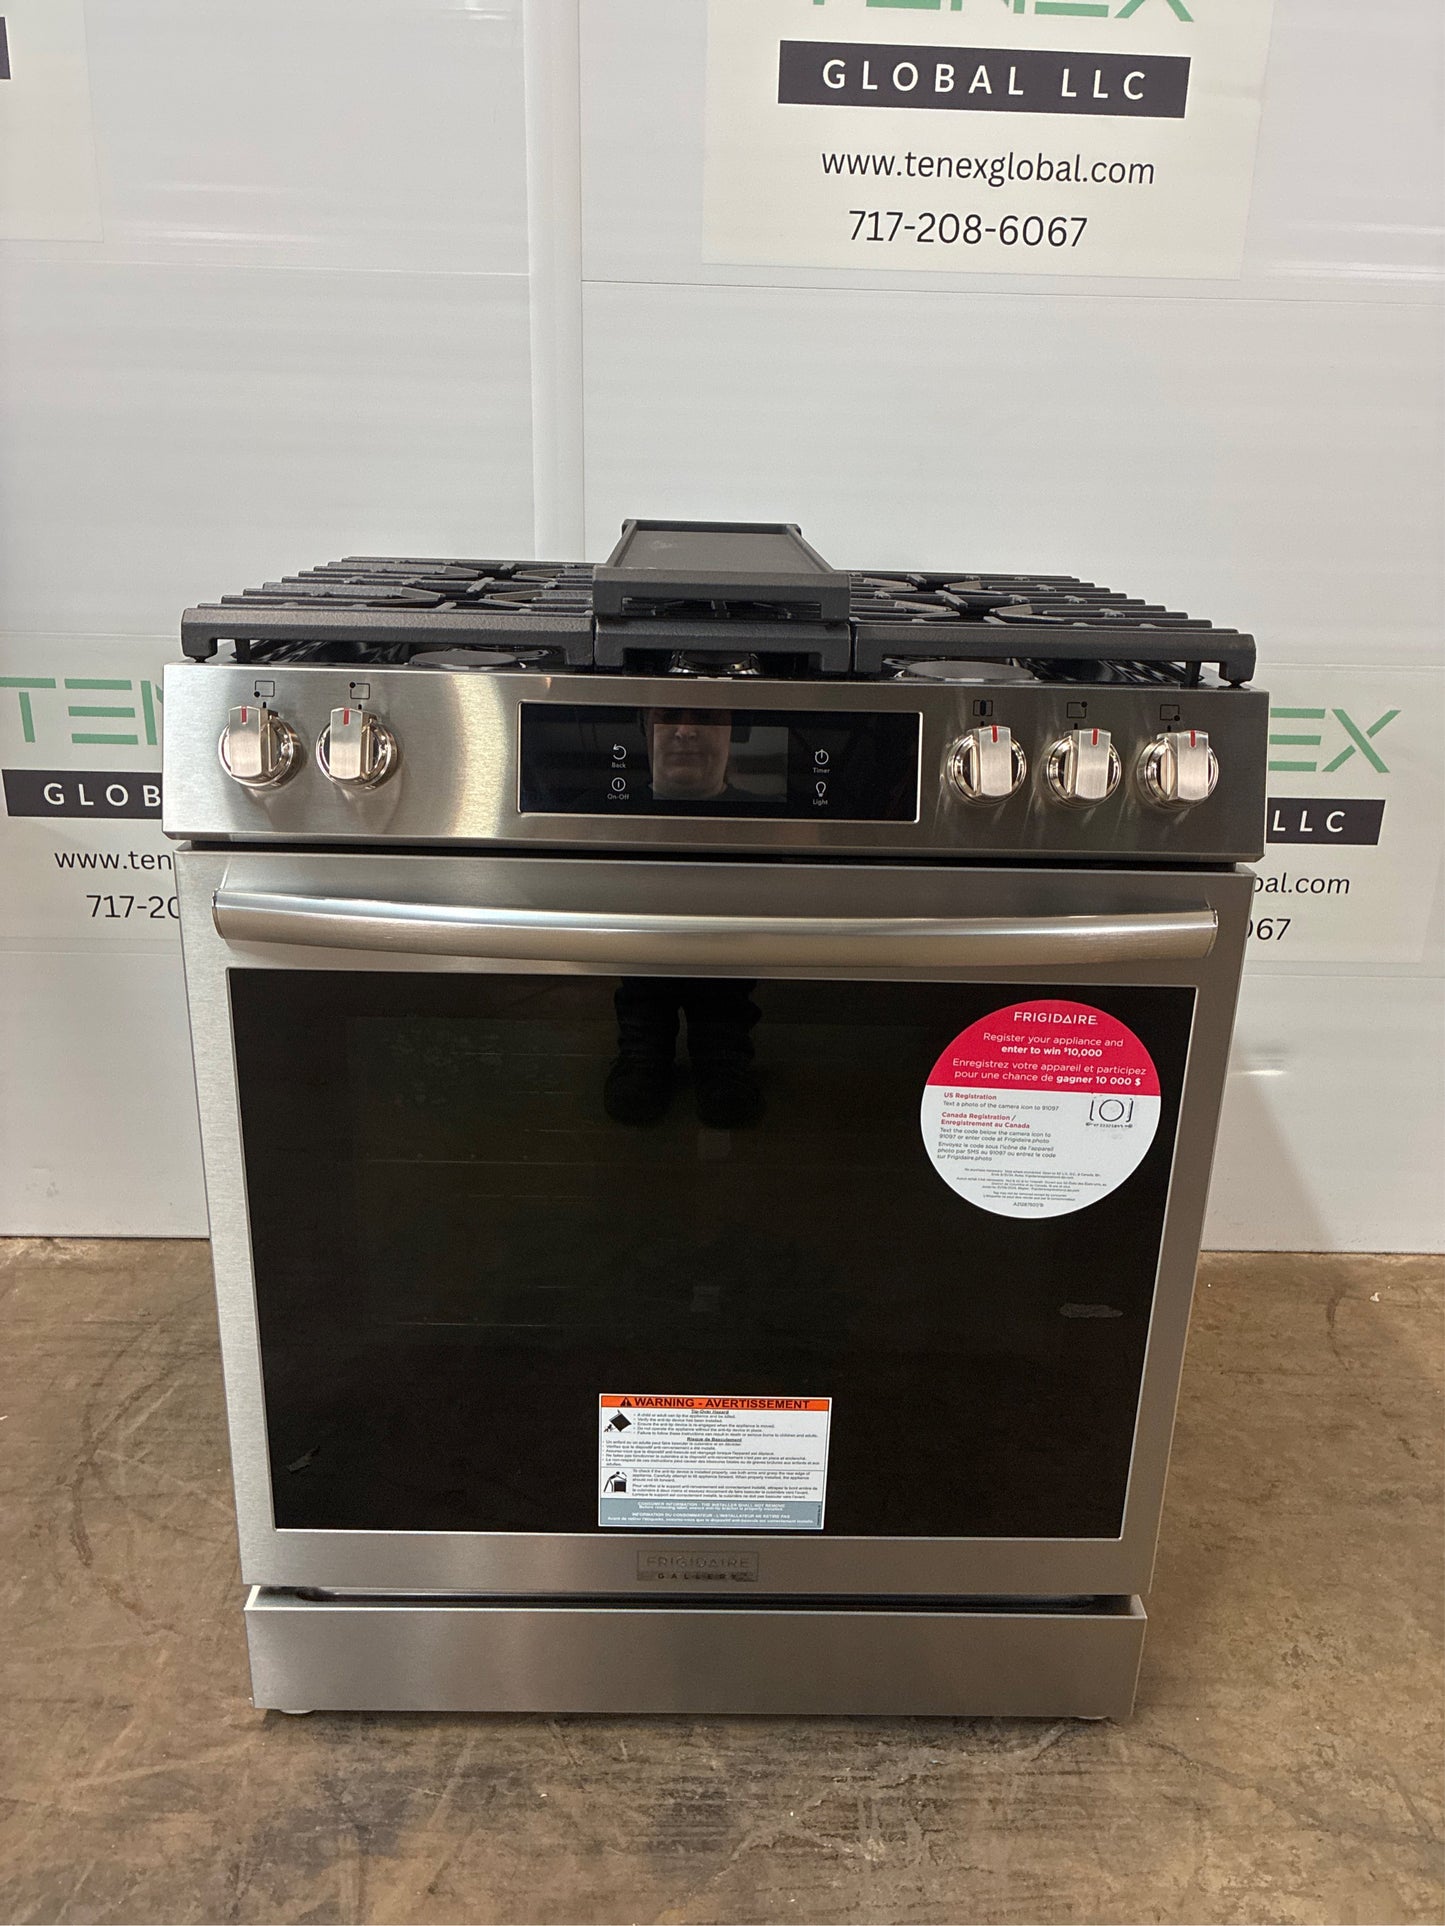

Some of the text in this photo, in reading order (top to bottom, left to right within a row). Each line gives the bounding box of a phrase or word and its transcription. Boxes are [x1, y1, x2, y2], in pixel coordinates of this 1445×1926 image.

[822, 59, 1145, 100] GLOBAL LLC
[821, 150, 1156, 187] www.tenexglobal.com
[848, 210, 1088, 247] 717-208-6067
[611, 761, 626, 769] Back
[43, 783, 161, 807] GLOB
[812, 798, 828, 806] Light
[1272, 810, 1346, 833] LLC
[86, 895, 180, 919] 717-20
[1014, 1011, 1098, 1025] FRIGIDAIRE
[983, 1032, 1123, 1047] Register your appliance and
[1001, 1045, 1102, 1059] enter to win $10,000
[952, 1058, 1146, 1076] Enregistrez votre appareil et participez
[954, 1070, 1140, 1086] pour une chance de gagner 10 000 $
[955, 1092, 996, 1101] Registration
[940, 1119, 992, 1127] Enregistrement
[968, 1113, 1010, 1121] Registration
[634, 1397, 694, 1408] WARNING
[705, 1399, 810, 1410] AVERTISSEMENT
